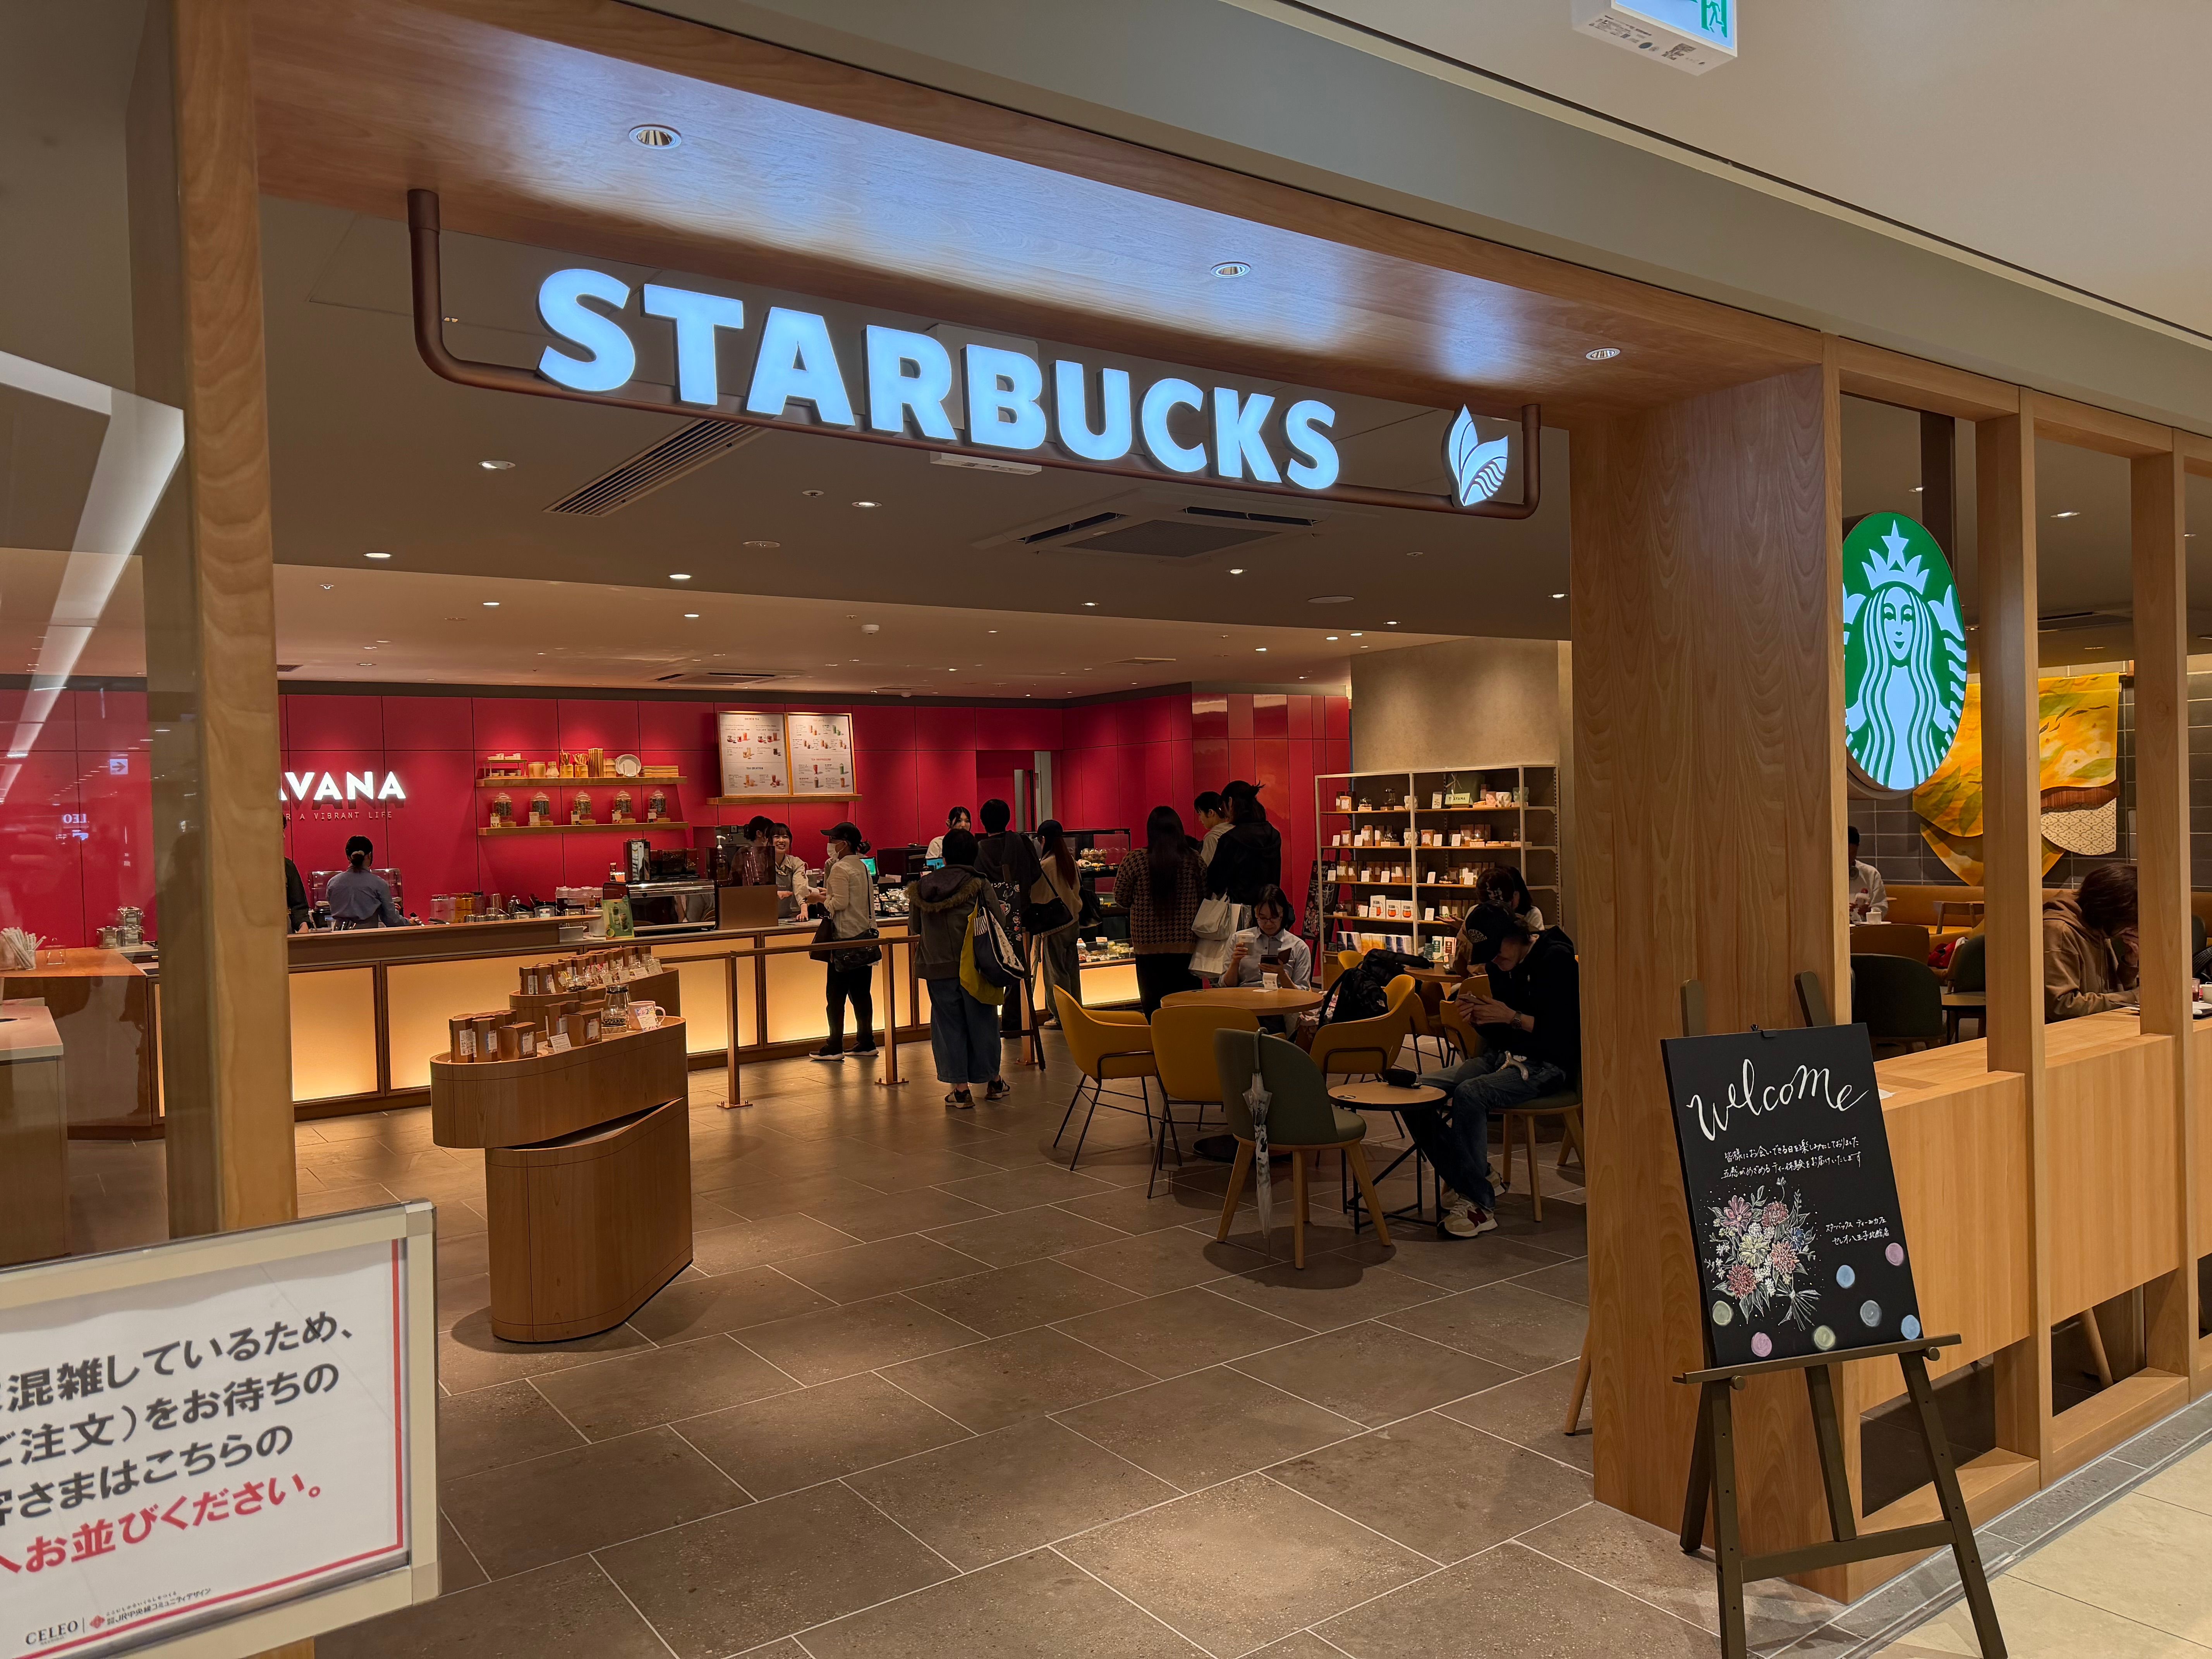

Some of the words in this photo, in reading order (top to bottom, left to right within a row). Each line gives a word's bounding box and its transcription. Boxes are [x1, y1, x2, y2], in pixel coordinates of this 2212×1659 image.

[537, 267, 1340, 491] STARBUCKS
[281, 771, 406, 800] VANA
[314, 812, 359, 820] VIBRANT
[1826, 1221, 1853, 1233] スターバックス
[0, 1311, 352, 1412] 混雑しているため、
[25, 1620, 78, 1645] CELEO
